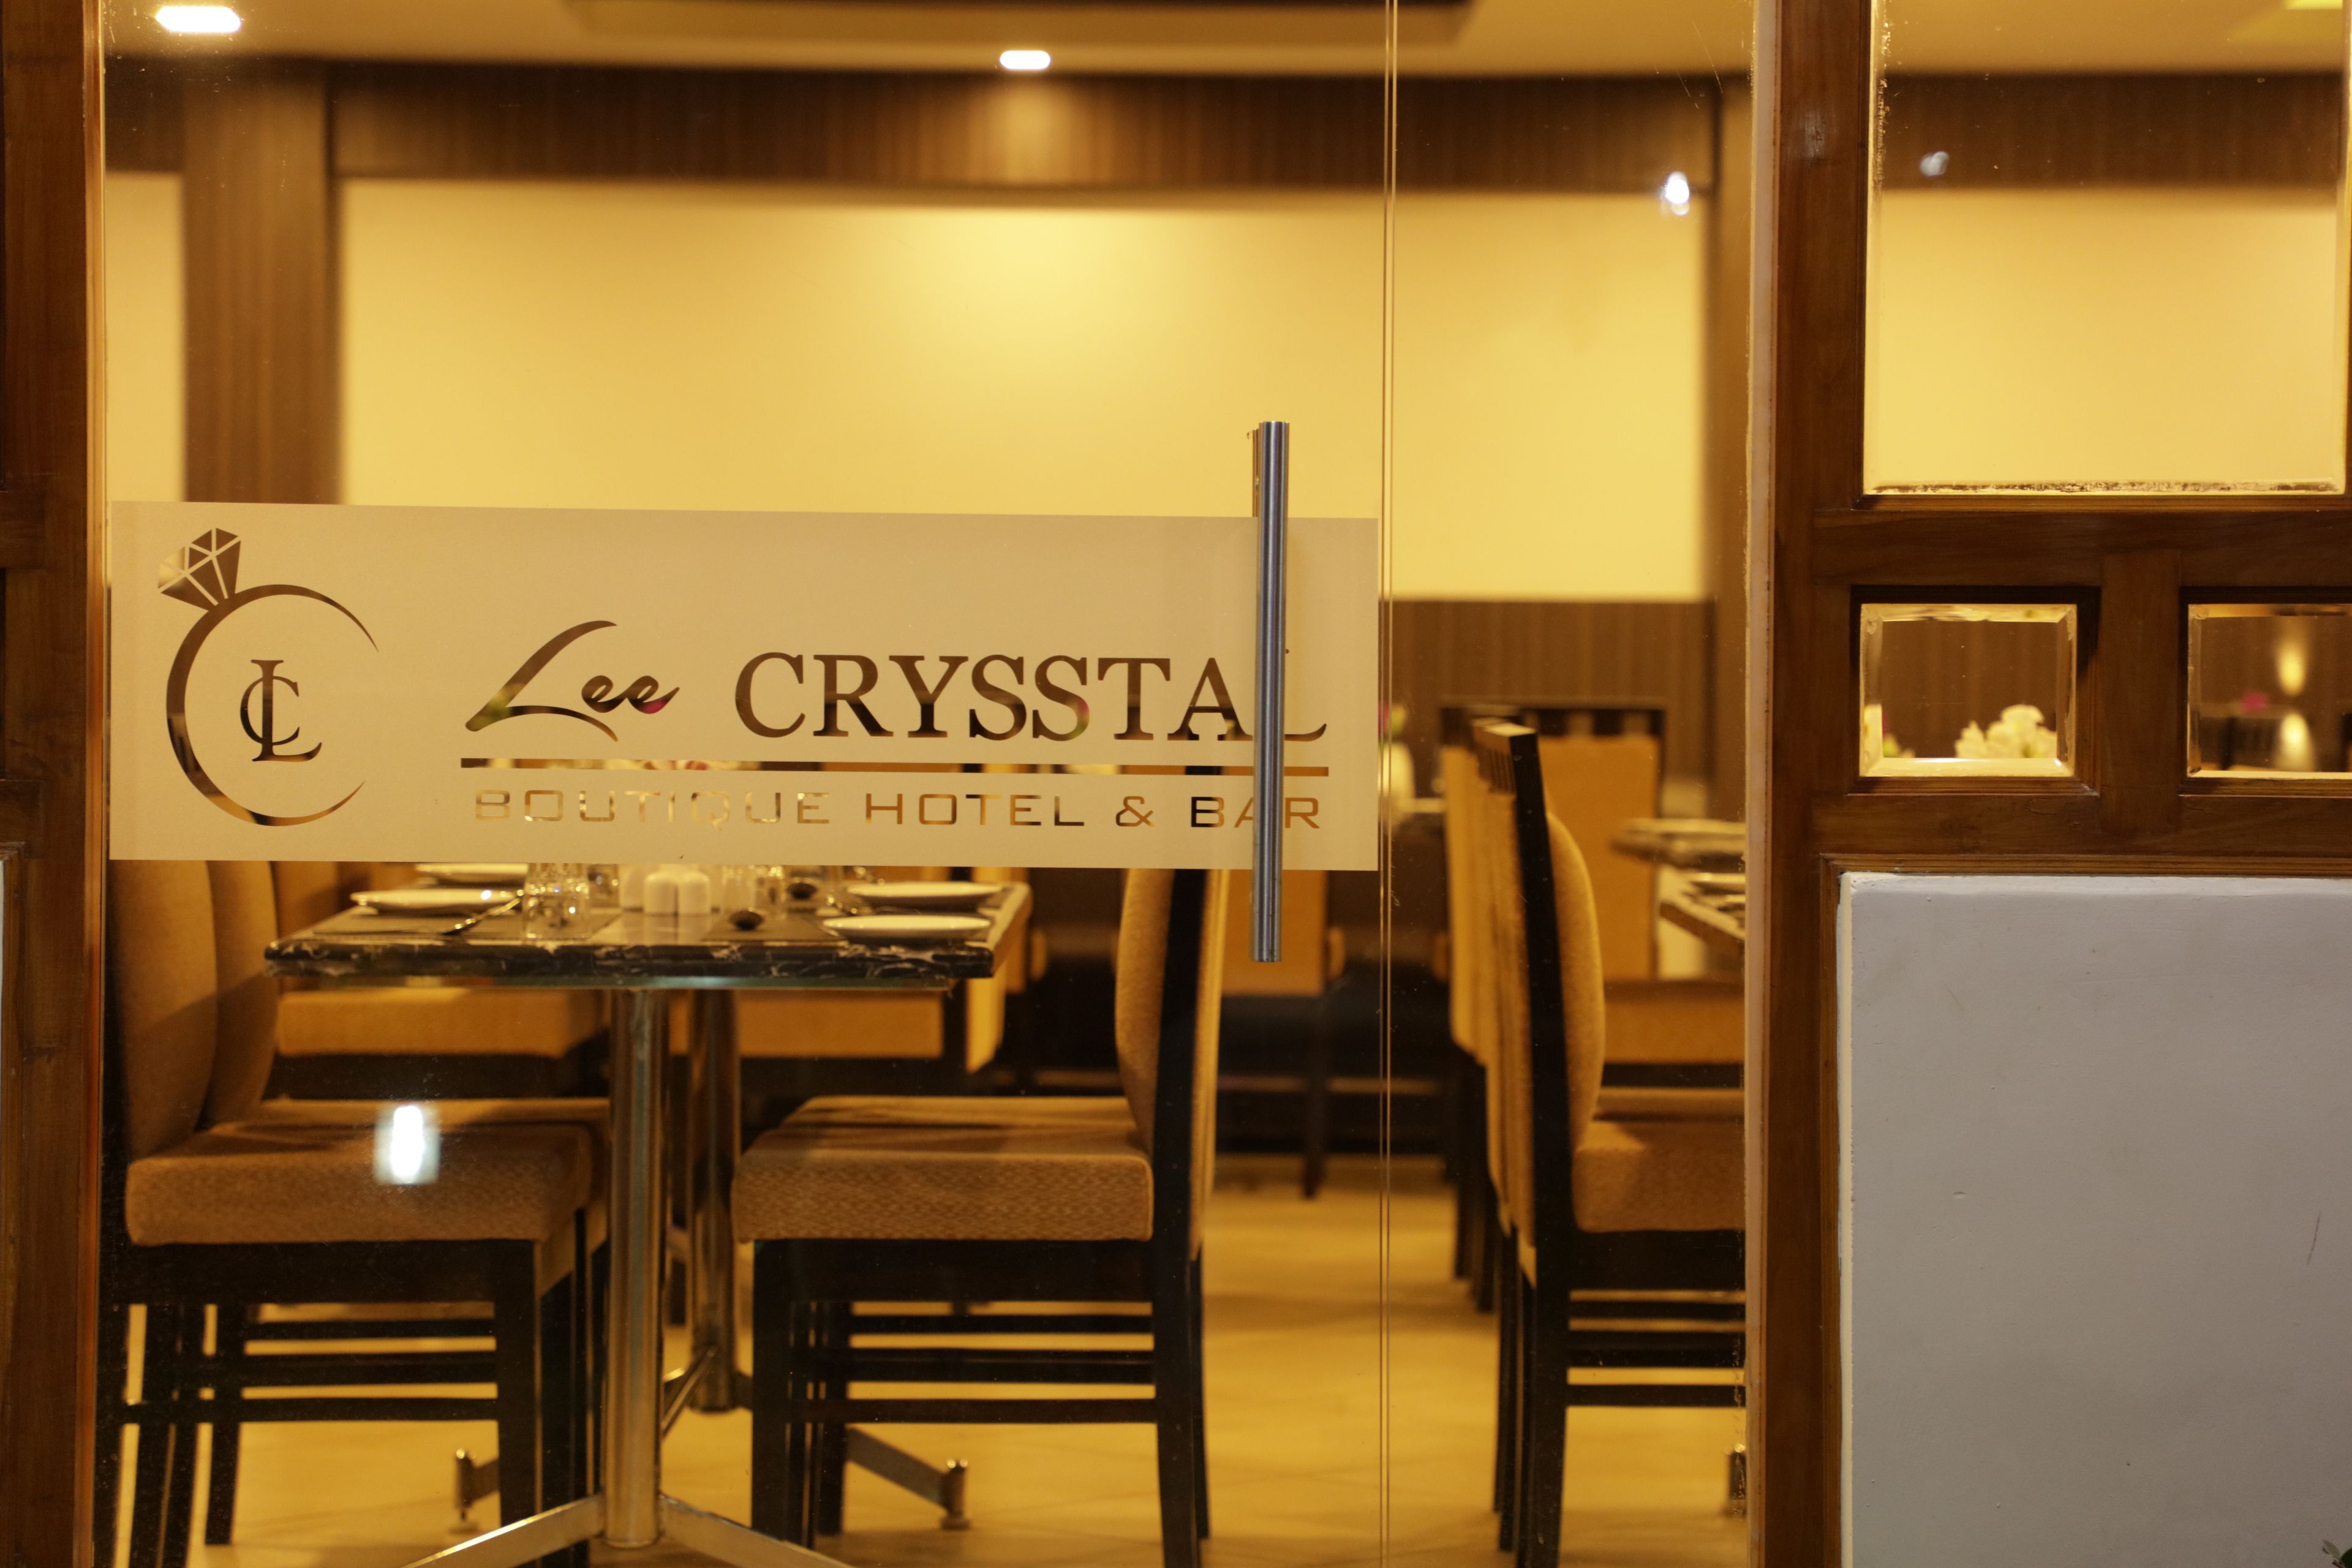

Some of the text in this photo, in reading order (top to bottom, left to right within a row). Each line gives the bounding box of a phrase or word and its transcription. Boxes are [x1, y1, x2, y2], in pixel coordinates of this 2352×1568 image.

[465, 620, 680, 742] Lee
[475, 789, 830, 831] BOUTIQUE
[865, 793, 1085, 826] HOTEL
[1115, 796, 1155, 827] &
